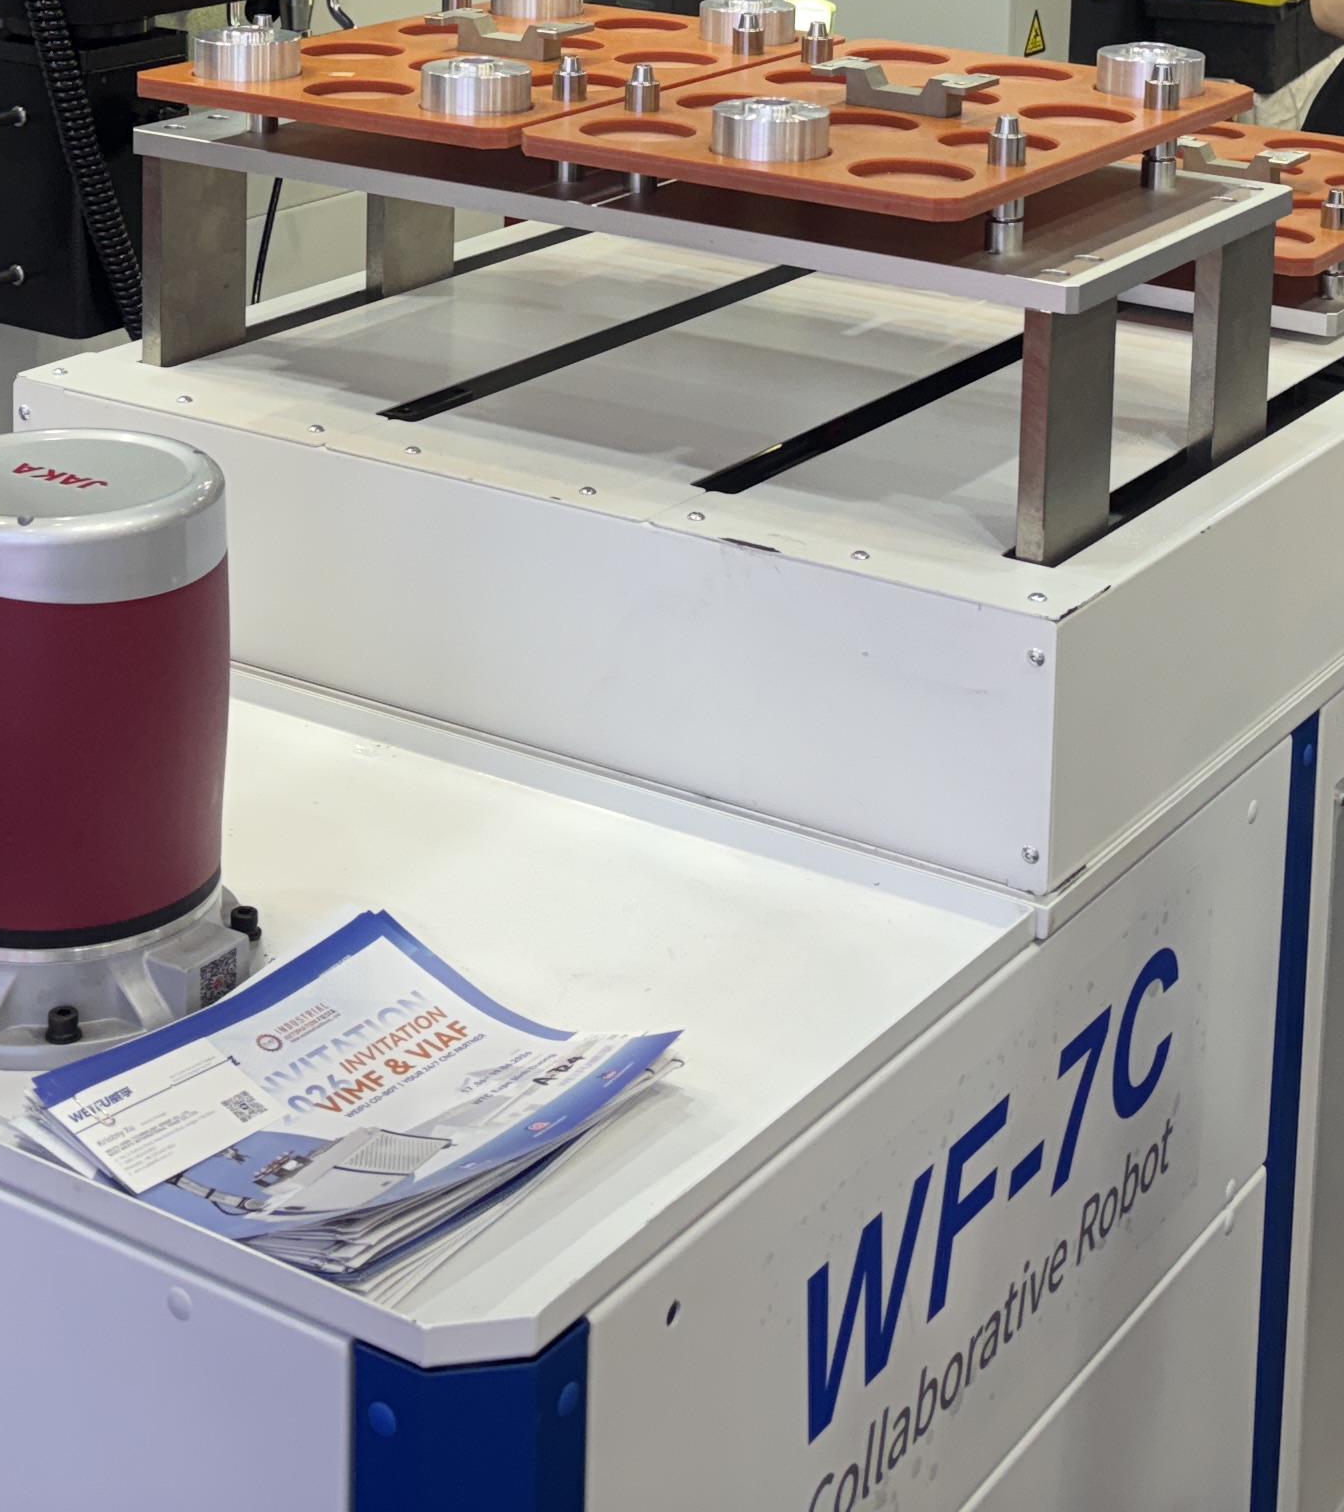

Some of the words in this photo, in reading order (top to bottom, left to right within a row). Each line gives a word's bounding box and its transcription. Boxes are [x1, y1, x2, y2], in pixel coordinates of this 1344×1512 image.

[12, 462, 108, 489] JAKA
[274, 1002, 330, 1035] INDUSTRIAL
[339, 1006, 448, 1074] INVITATION
[313, 1070, 385, 1113] VIMF
[384, 1058, 417, 1076] &
[404, 1020, 469, 1060] VIAF
[807, 947, 1178, 1446] WF-7C
[808, 1239, 1066, 1512] Collaborative
[1076, 1119, 1173, 1265] Robot
